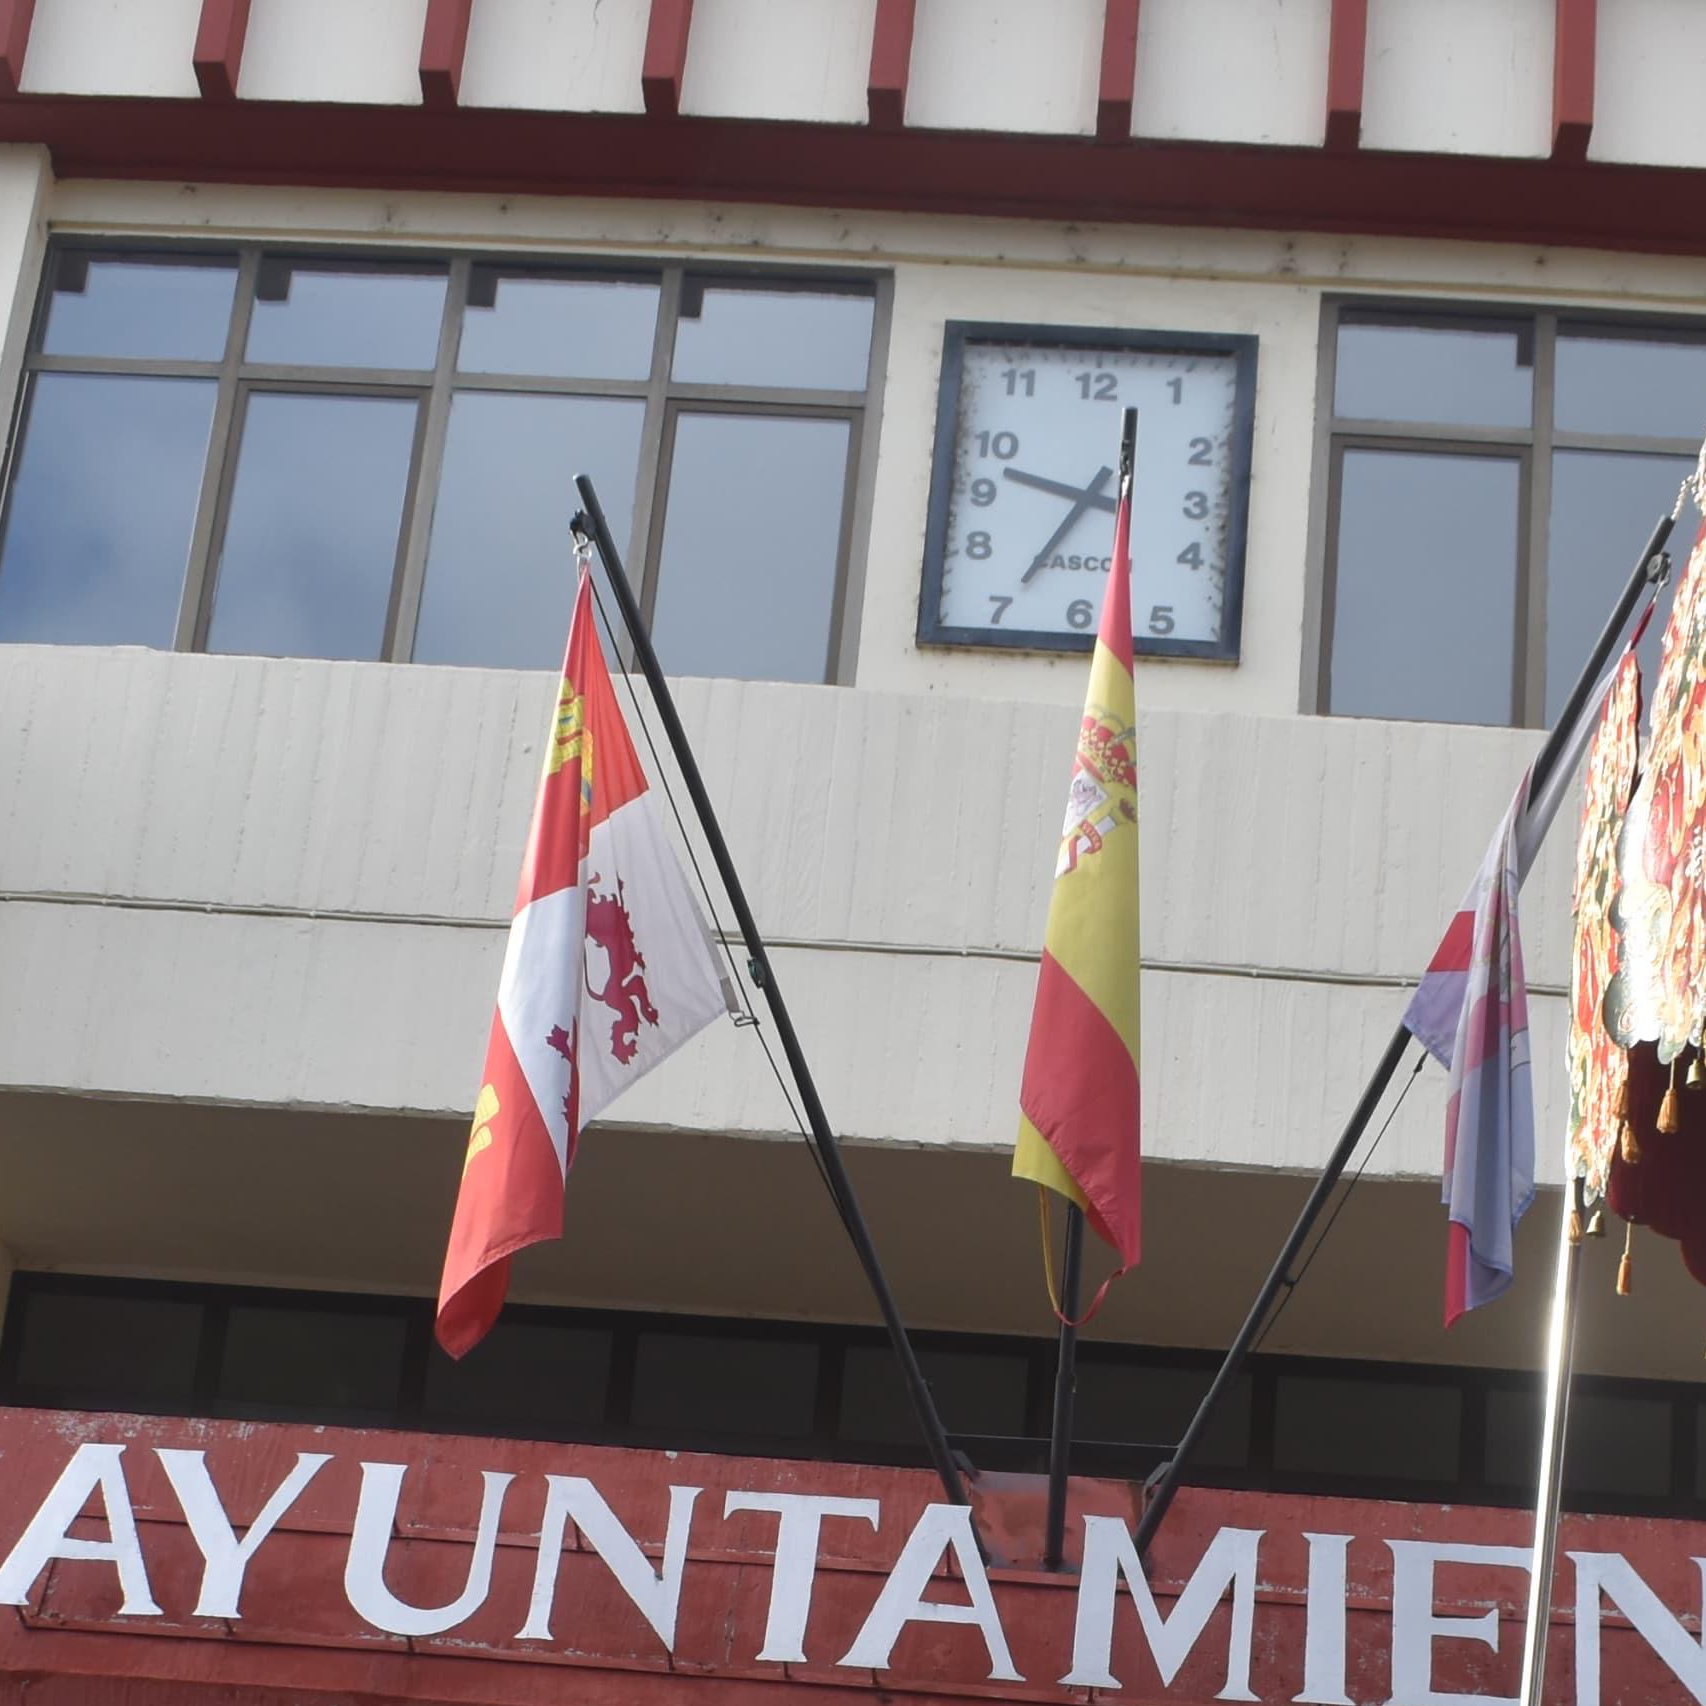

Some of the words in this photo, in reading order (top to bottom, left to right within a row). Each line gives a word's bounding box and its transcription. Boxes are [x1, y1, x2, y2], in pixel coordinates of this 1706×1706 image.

[1001, 369, 1036, 397] 11
[1075, 373, 1118, 401] 12
[1166, 377, 1183, 405] 1
[975, 431, 1019, 460] 10
[1188, 438, 1213, 466] 2
[970, 478, 997, 507] 9
[1183, 491, 1209, 520] 3
[965, 531, 992, 560] 8
[1177, 542, 1204, 571] 4
[1034, 555, 1133, 574] ASCO
[989, 596, 1013, 624] 7
[1066, 600, 1093, 629] 6
[1149, 606, 1175, 635] 5
